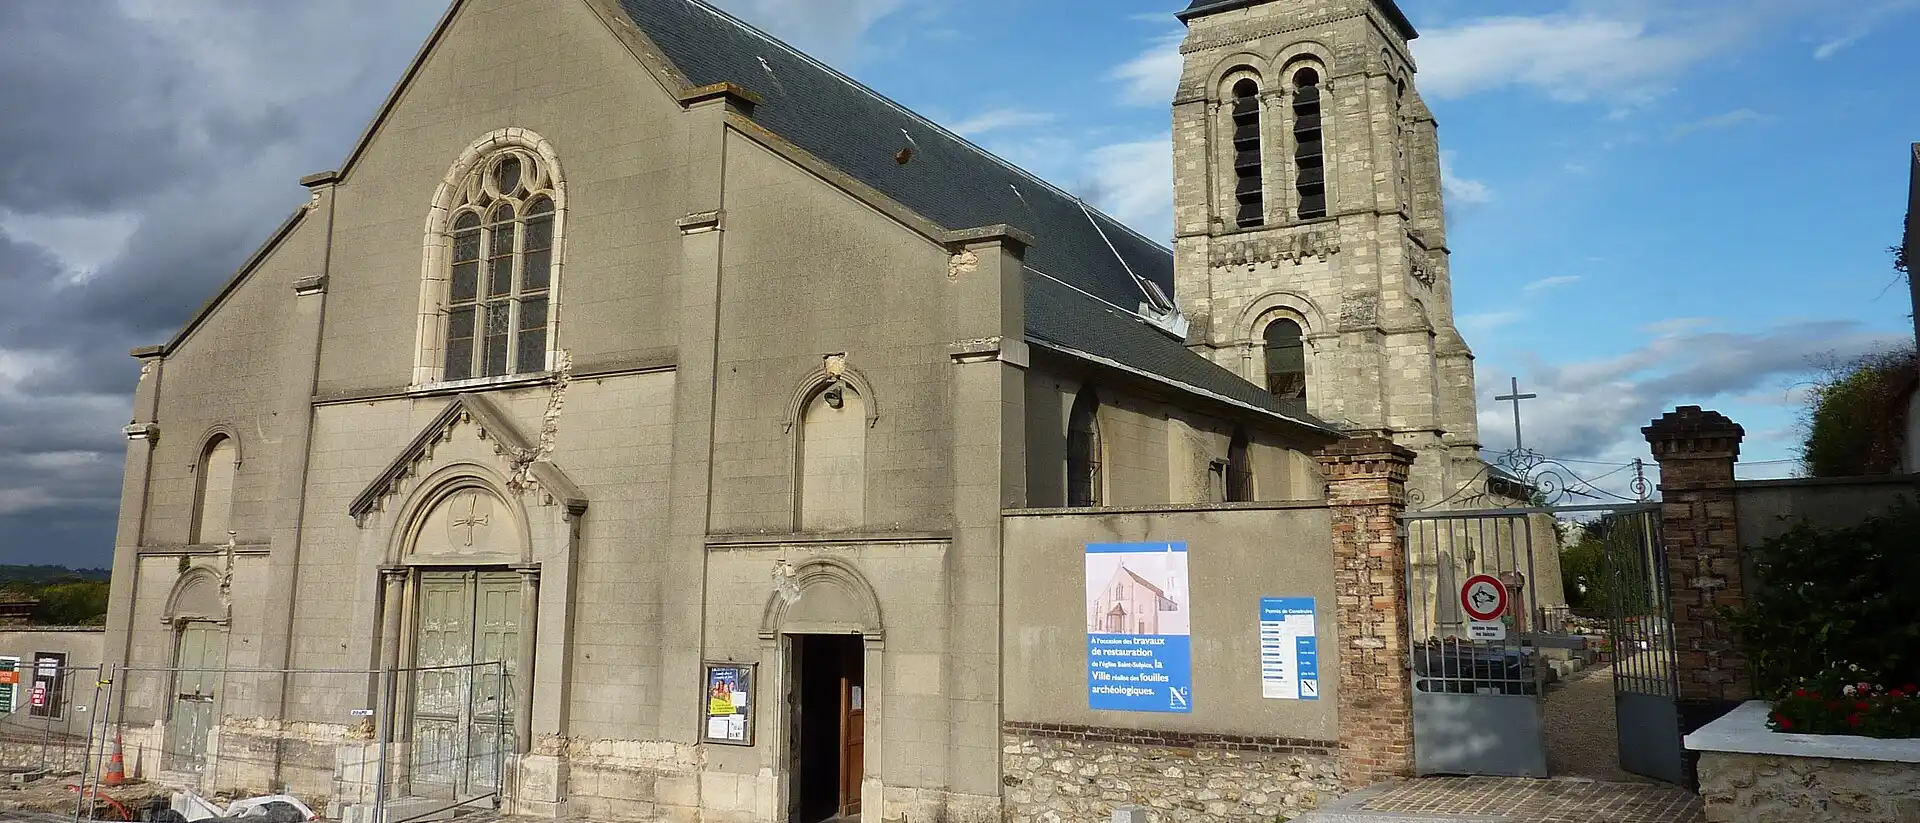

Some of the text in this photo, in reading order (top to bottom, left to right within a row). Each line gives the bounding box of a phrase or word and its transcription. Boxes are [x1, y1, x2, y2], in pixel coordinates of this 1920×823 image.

[1133, 637, 1165, 645] travaux
[1092, 647, 1152, 657] de restauration
[1154, 660, 1163, 669] la
[1092, 671, 1111, 681] Ville
[1140, 672, 1169, 682] fouilles
[1092, 685, 1154, 697] archéologiques.
